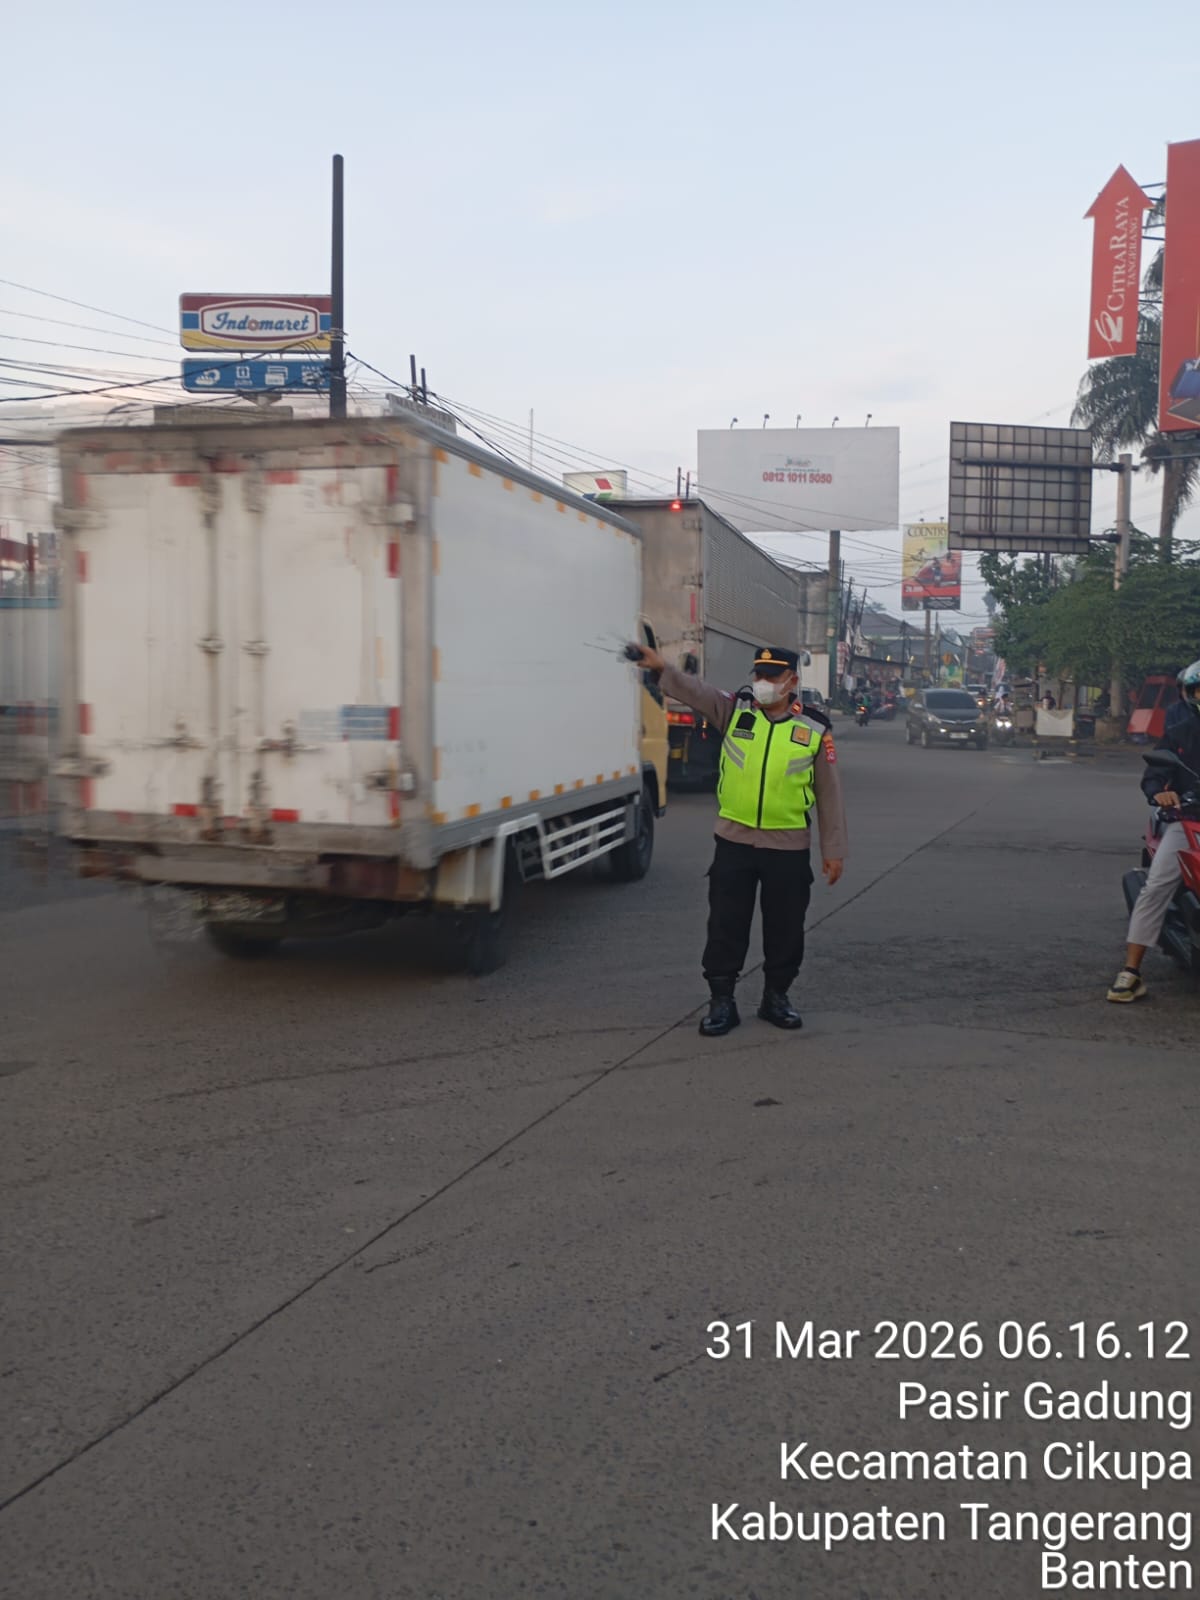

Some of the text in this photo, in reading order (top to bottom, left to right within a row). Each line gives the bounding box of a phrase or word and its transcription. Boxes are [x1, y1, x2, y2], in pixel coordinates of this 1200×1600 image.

[1128, 218, 1139, 286] TANGERANG
[211, 311, 310, 332] Indomaret
[762, 471, 833, 485] 0812 1011 5050
